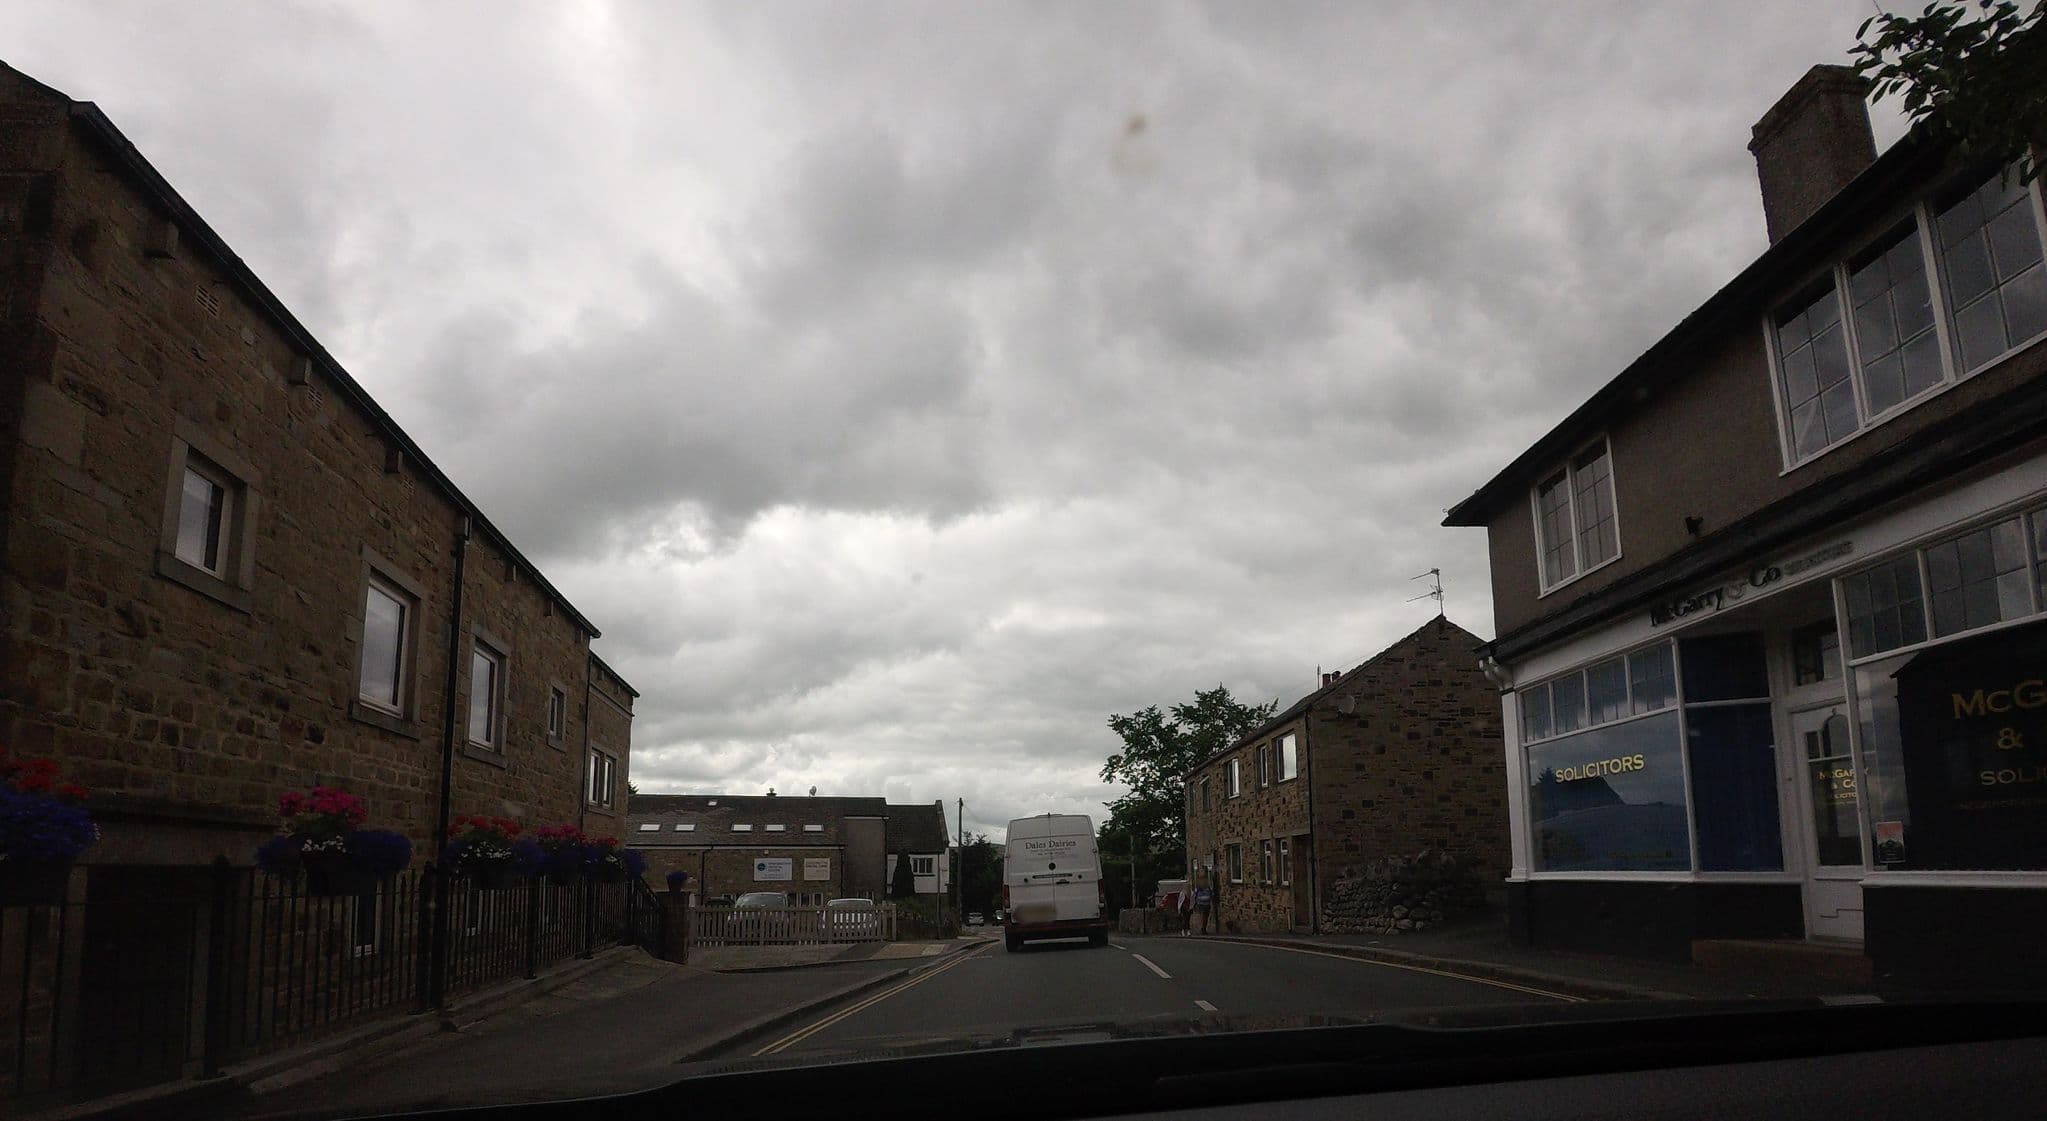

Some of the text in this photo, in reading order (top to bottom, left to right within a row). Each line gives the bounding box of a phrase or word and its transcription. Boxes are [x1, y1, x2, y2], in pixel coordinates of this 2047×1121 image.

[1997, 727, 2024, 751] &
[1555, 754, 1645, 784] SOLICITORS
[1025, 840, 1076, 849] Dales Dairies
